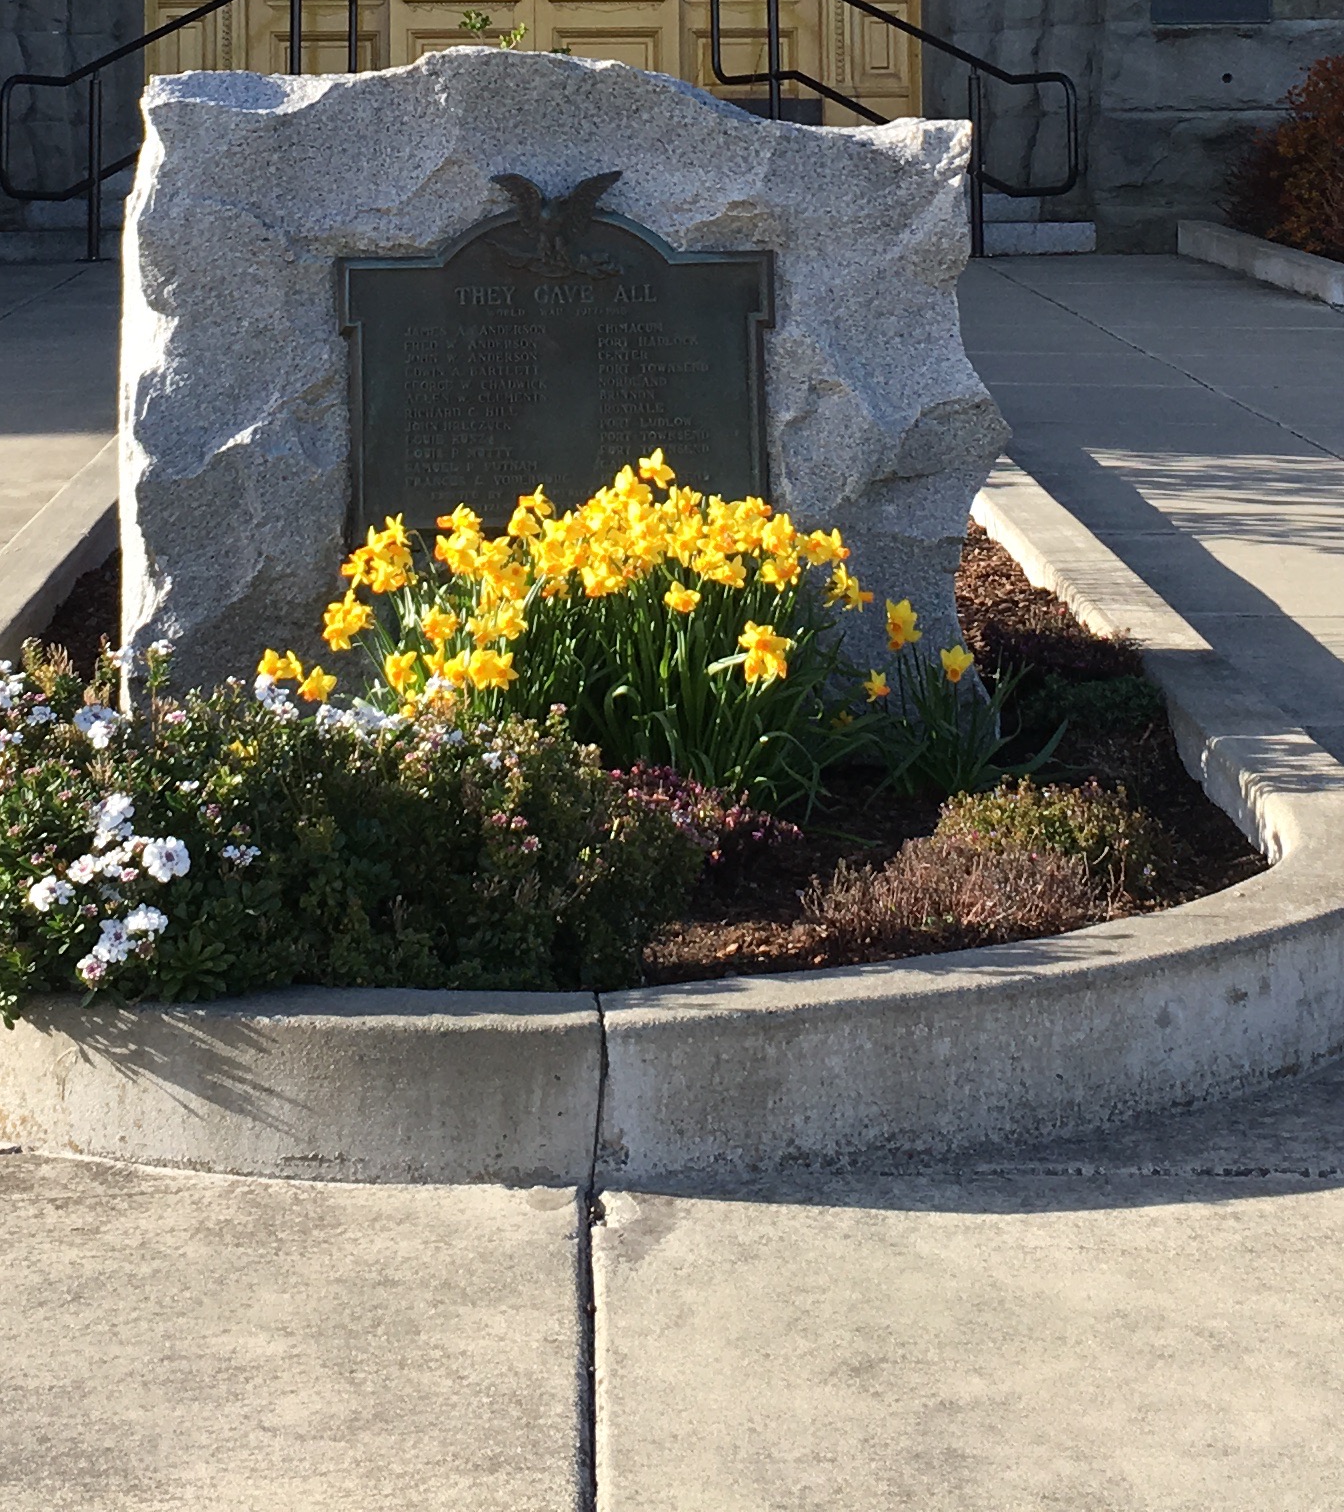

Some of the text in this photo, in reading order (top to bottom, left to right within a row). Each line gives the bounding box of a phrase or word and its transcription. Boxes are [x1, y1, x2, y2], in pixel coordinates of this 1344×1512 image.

[454, 283, 658, 306] THEY GAVE ALL
[485, 307, 526, 317] WORLD
[539, 307, 564, 317] WAR
[404, 325, 447, 337] JAMES
[479, 323, 547, 336] ANDERSON
[404, 340, 438, 351] FRED
[468, 338, 537, 350] ANDERSON
[597, 334, 699, 348] PORT HADLOCK
[404, 353, 438, 364] JOHN
[468, 351, 537, 363] ANDERSON
[597, 349, 648, 360] CENTER
[469, 364, 539, 377] BARTLETT
[598, 361, 710, 375] PORT TOWNSEND
[404, 379, 453, 391] GEORGE
[480, 378, 547, 390] CHADWICK
[598, 376, 668, 388] NORDLAND
[599, 388, 655, 400] BRINNON
[404, 406, 461, 419] RICHARD
[599, 402, 665, 414] IRONDALE
[404, 420, 438, 432] JOHN
[599, 416, 693, 429] PORT LUDLOW
[404, 433, 443, 446] LOUIE
[599, 429, 709, 442] PORT TOWNSEND
[404, 447, 443, 459] LOUIE
[599, 445, 631, 456] PORT
[404, 461, 459, 473] SAMUEL
[484, 460, 538, 472] PUTNAM
